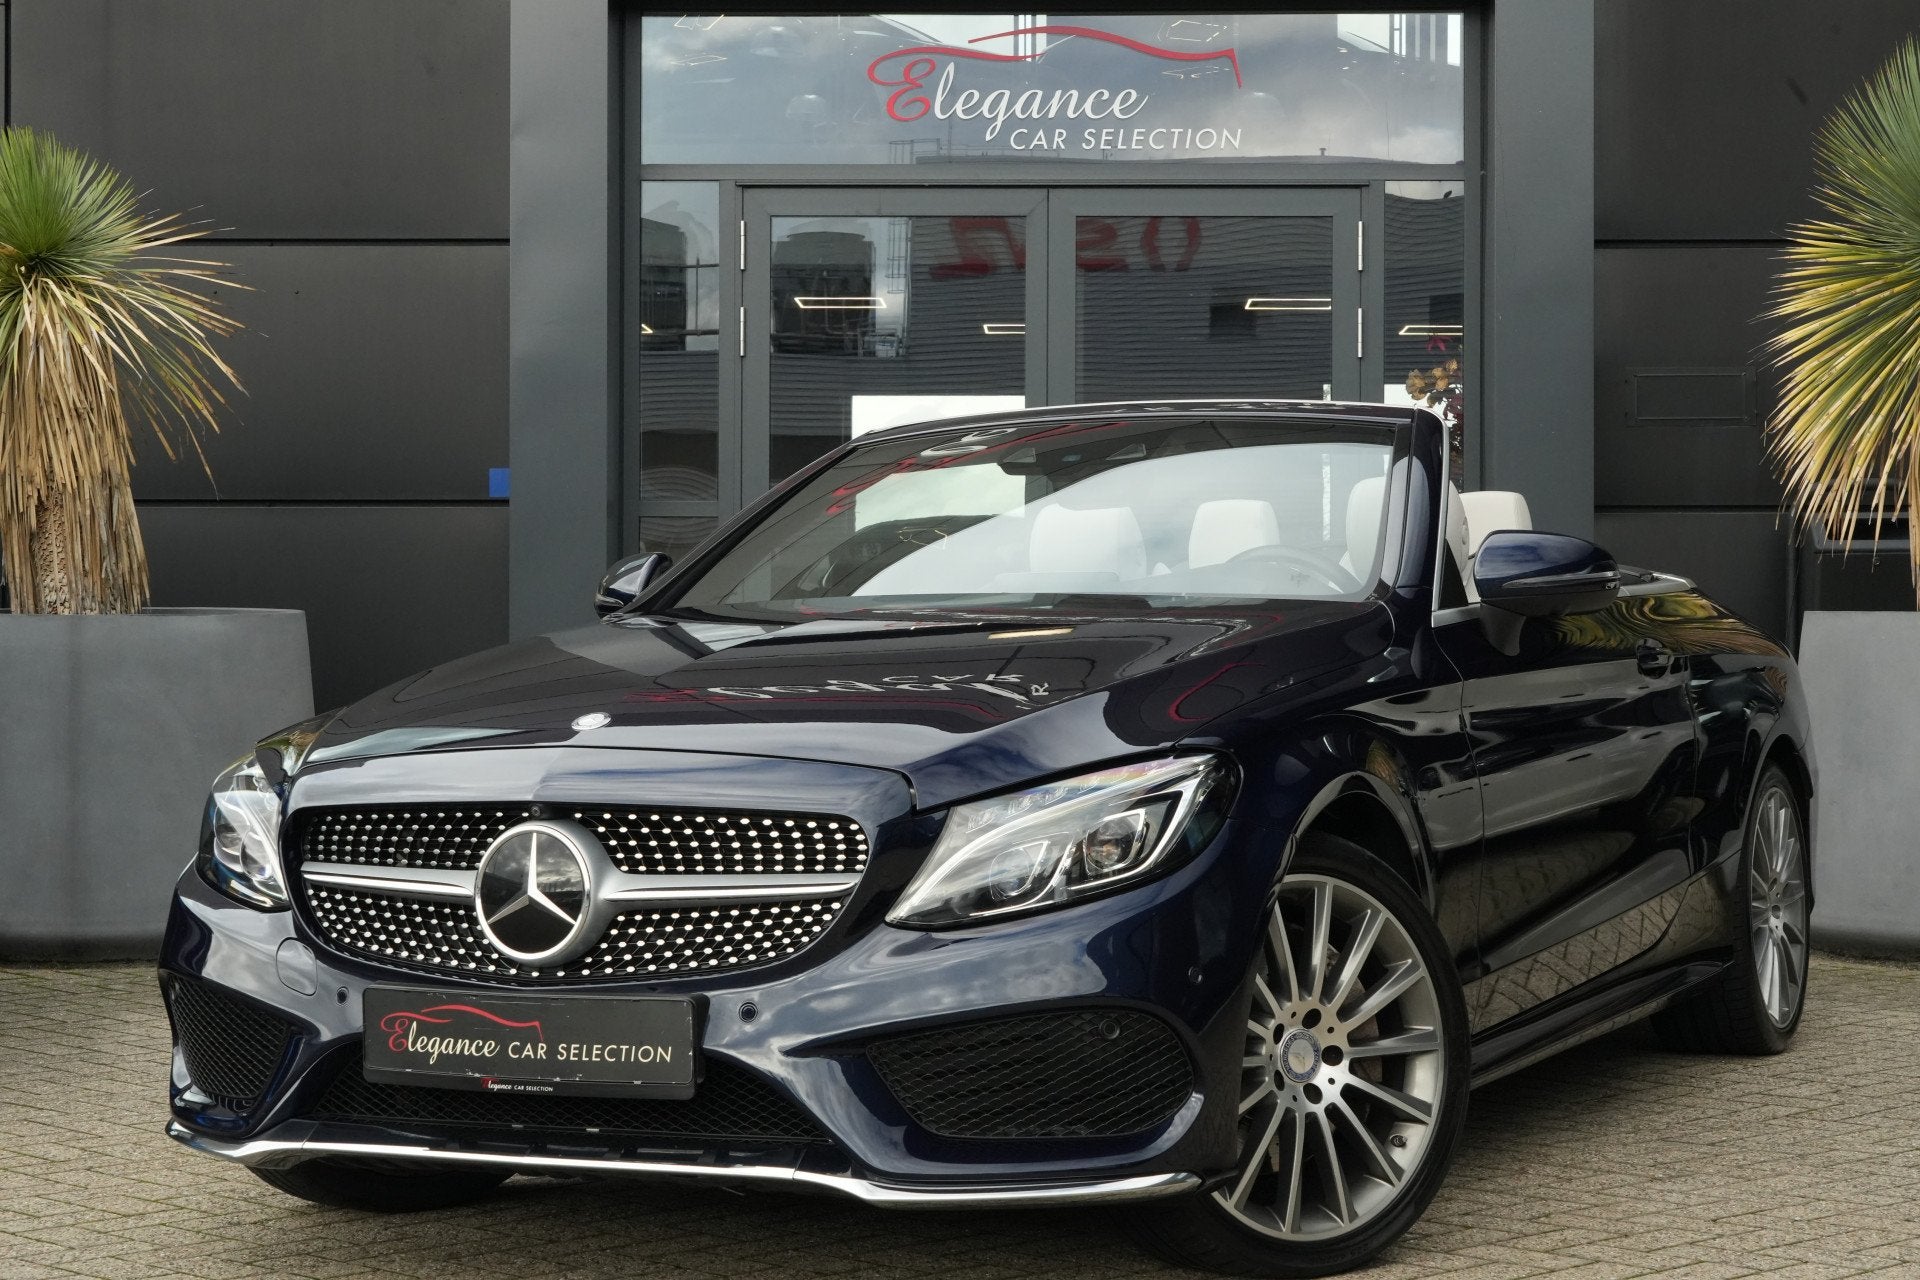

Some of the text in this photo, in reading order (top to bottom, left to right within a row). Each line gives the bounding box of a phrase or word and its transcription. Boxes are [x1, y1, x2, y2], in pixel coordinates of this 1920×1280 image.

[867, 48, 1242, 150] Elegance CAR SELECTION
[380, 1013, 672, 1064] Elegance CAR SELECTION
